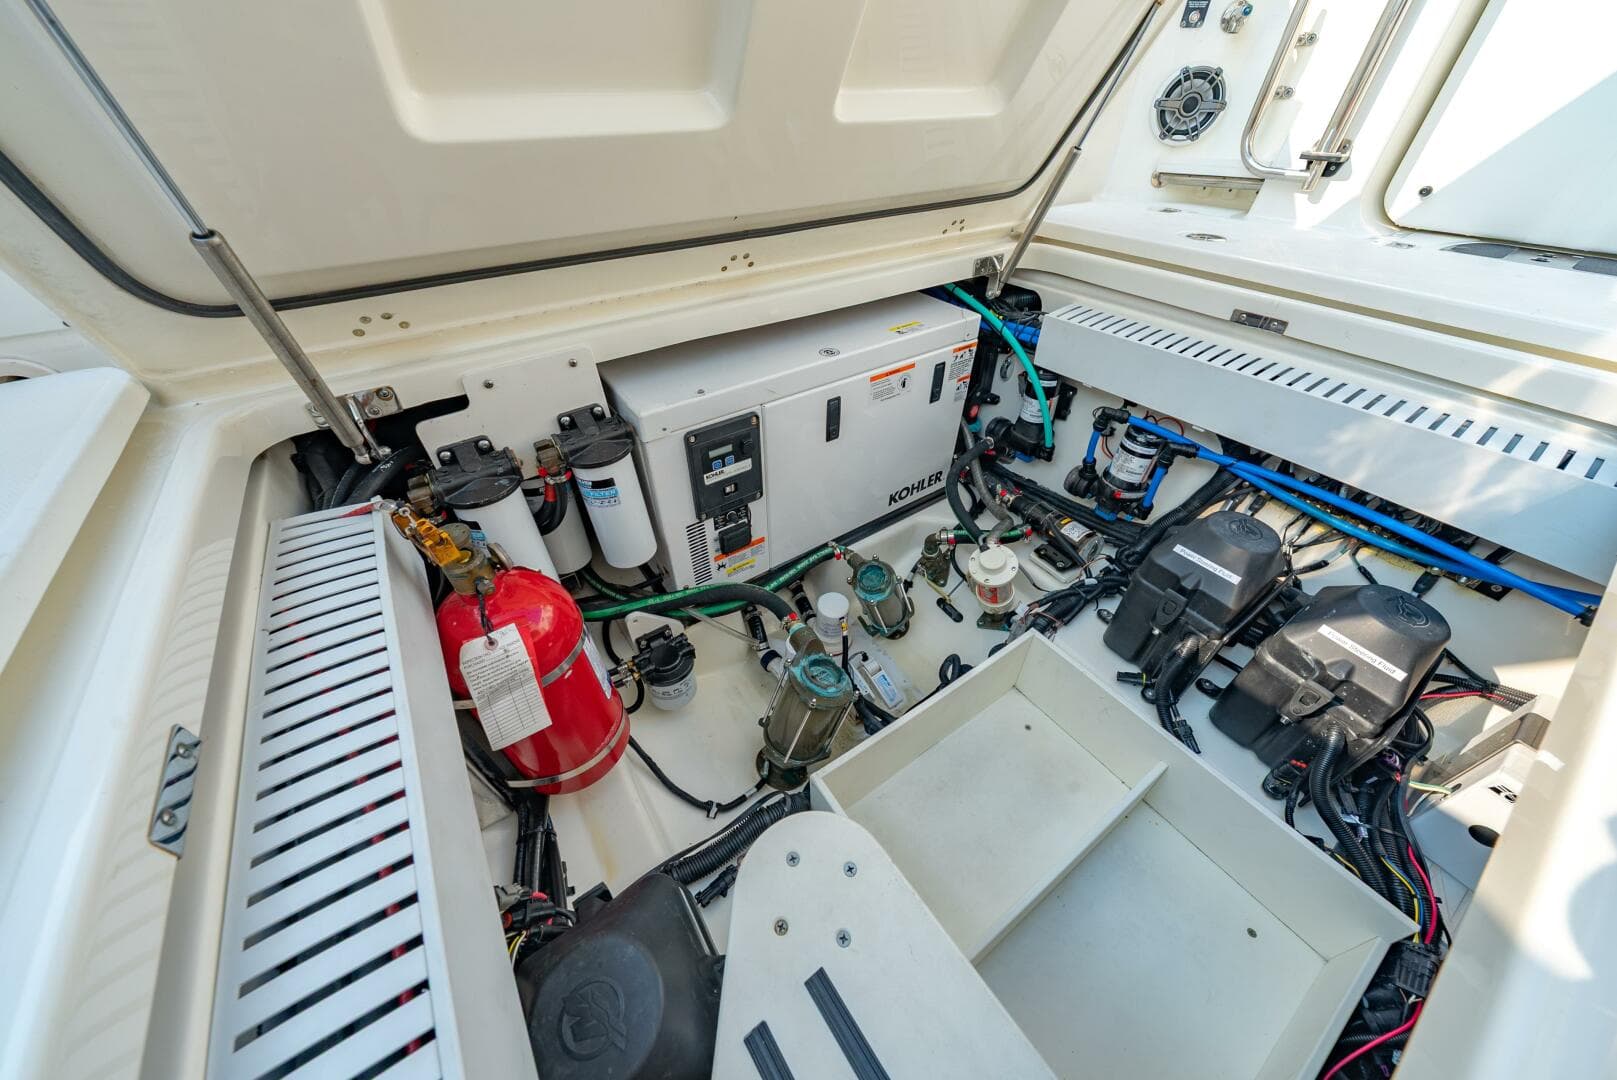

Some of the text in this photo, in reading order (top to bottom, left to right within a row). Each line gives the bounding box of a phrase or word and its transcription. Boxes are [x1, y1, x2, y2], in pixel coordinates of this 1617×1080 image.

[705, 469, 725, 480] KOHLER
[888, 470, 943, 507] KOHLER
[1348, 644, 1377, 664] Steering
[1377, 661, 1397, 674] Fluid
